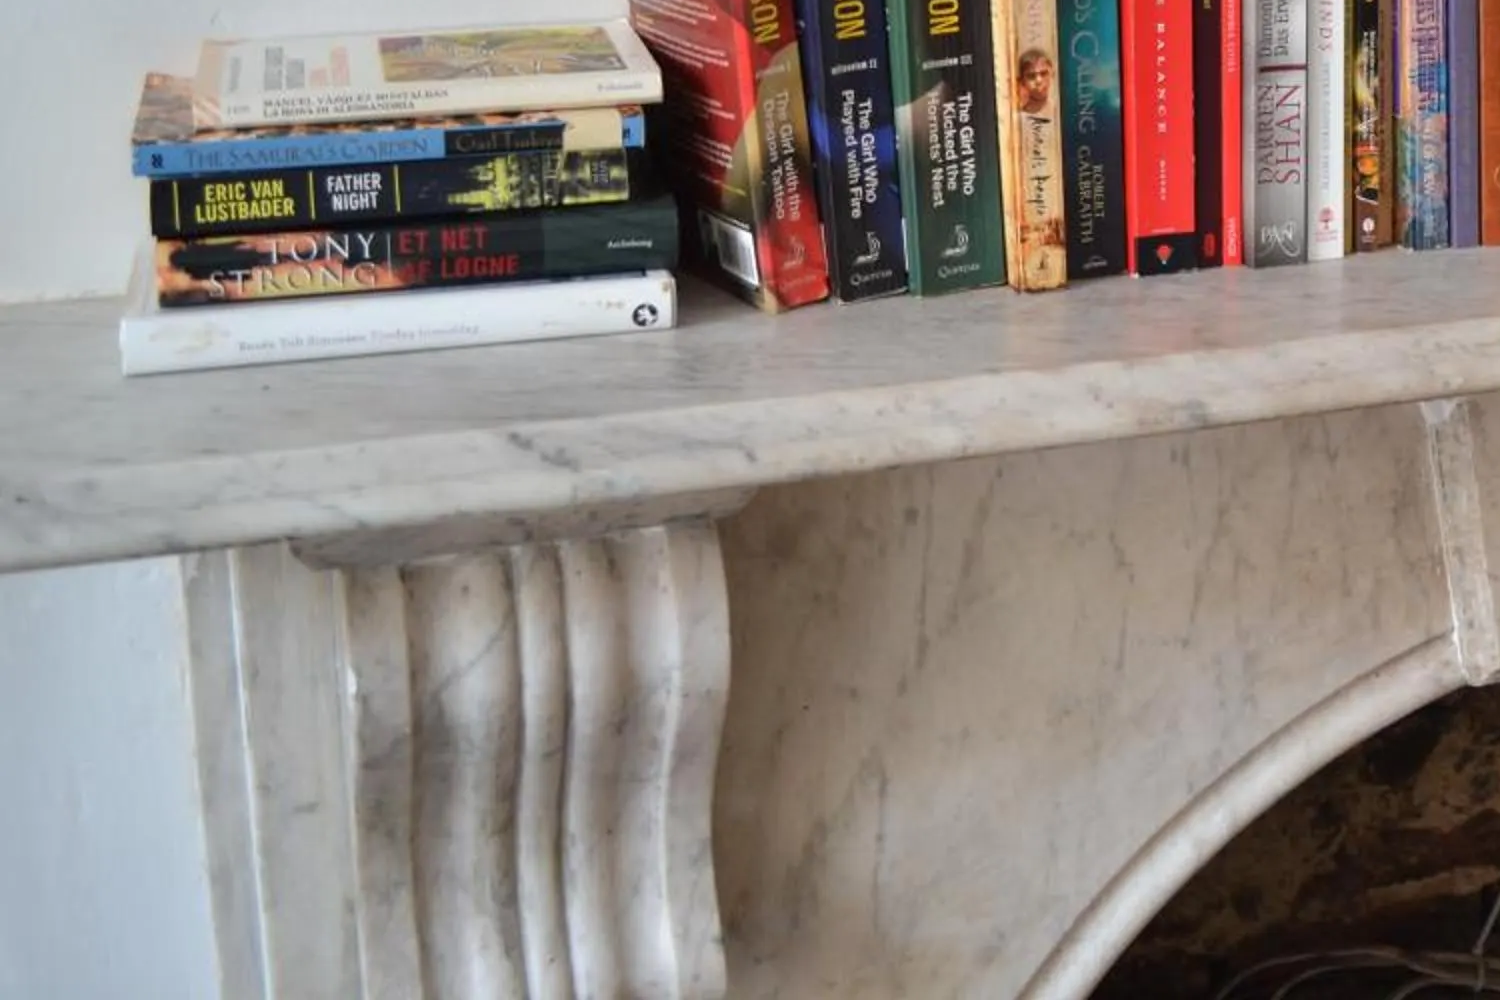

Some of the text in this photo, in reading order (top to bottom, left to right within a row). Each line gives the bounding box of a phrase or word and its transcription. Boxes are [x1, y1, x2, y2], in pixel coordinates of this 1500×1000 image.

[1274, 28, 1290, 58] Das
[1071, 30, 1100, 134] CALLING
[1156, 23, 1168, 133] BALANCE
[186, 148, 223, 170] THE
[339, 135, 428, 162] GARDEN
[776, 91, 801, 221] The Girl with the
[842, 89, 864, 219] Played with Fire
[857, 97, 880, 204] The Girl Who
[942, 102, 959, 192] Kicked the
[957, 91, 977, 197] The Girl Who
[1257, 84, 1275, 186] DARREN
[1275, 83, 1301, 185] SHAN
[195, 196, 296, 224] LUSTBADER
[203, 178, 285, 203] ERIC VAN
[326, 172, 383, 194] FATHER
[331, 191, 379, 213] NIGHT
[770, 166, 786, 220] Tattoo
[931, 168, 946, 209] Nest
[1077, 145, 1096, 245] GALBRAITH
[1092, 163, 1105, 219] ROBERT
[266, 232, 377, 265] TONY
[398, 229, 430, 255] ET
[208, 261, 378, 298] STRONG
